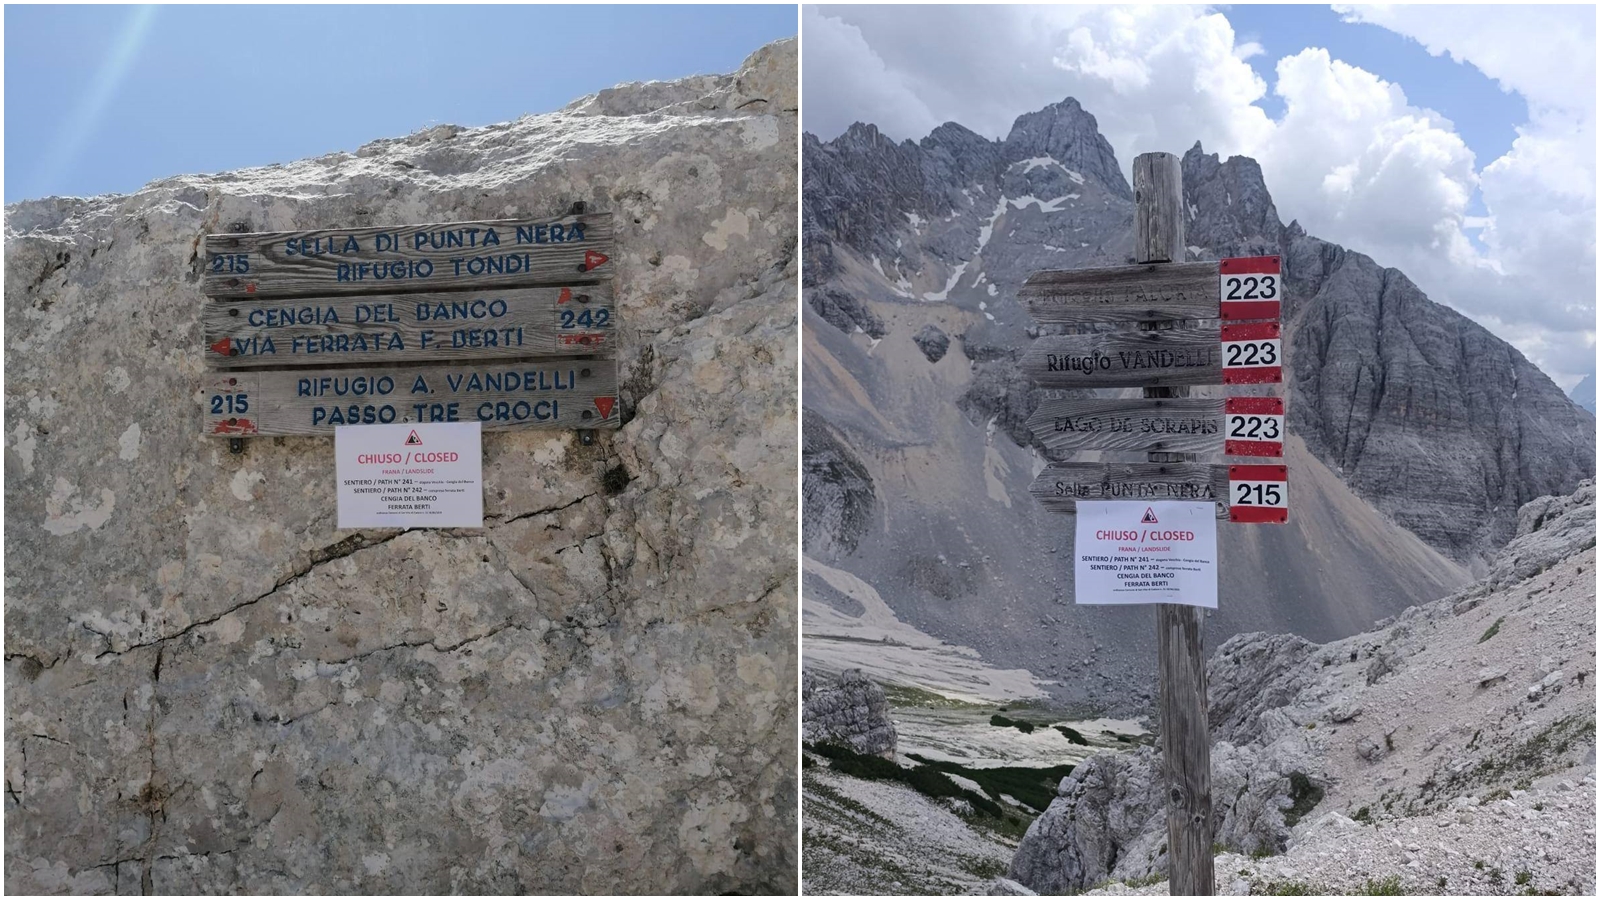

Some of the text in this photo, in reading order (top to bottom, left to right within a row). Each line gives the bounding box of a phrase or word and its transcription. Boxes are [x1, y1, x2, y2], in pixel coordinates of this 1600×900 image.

[286, 222, 585, 256] SELLA DI PUNTA NERA
[212, 255, 249, 274] 215
[337, 254, 530, 282] RIFUGIO TONDI
[1226, 275, 1276, 301] 223
[248, 299, 508, 327] CENGIA DEL BANCO
[560, 308, 610, 329] 242
[236, 327, 523, 355] VIA FERRATA F. BERTI
[1047, 350, 1213, 375] Rifugio VANDELLI
[1227, 342, 1276, 366] 223
[298, 370, 575, 397] RIFUGIO A. VANDELLI
[211, 394, 249, 414] 215
[312, 400, 558, 425] PASSO TRE CROCI
[1054, 417, 1102, 433] LAGO
[1231, 416, 1280, 438] 223
[358, 452, 459, 465] CHIUSO / CLOSED
[1101, 482, 1156, 497] PUNTA
[1167, 482, 1216, 498] NERA
[1237, 483, 1281, 505] 215
[1096, 530, 1194, 543] CHIUSO / CLOSED
